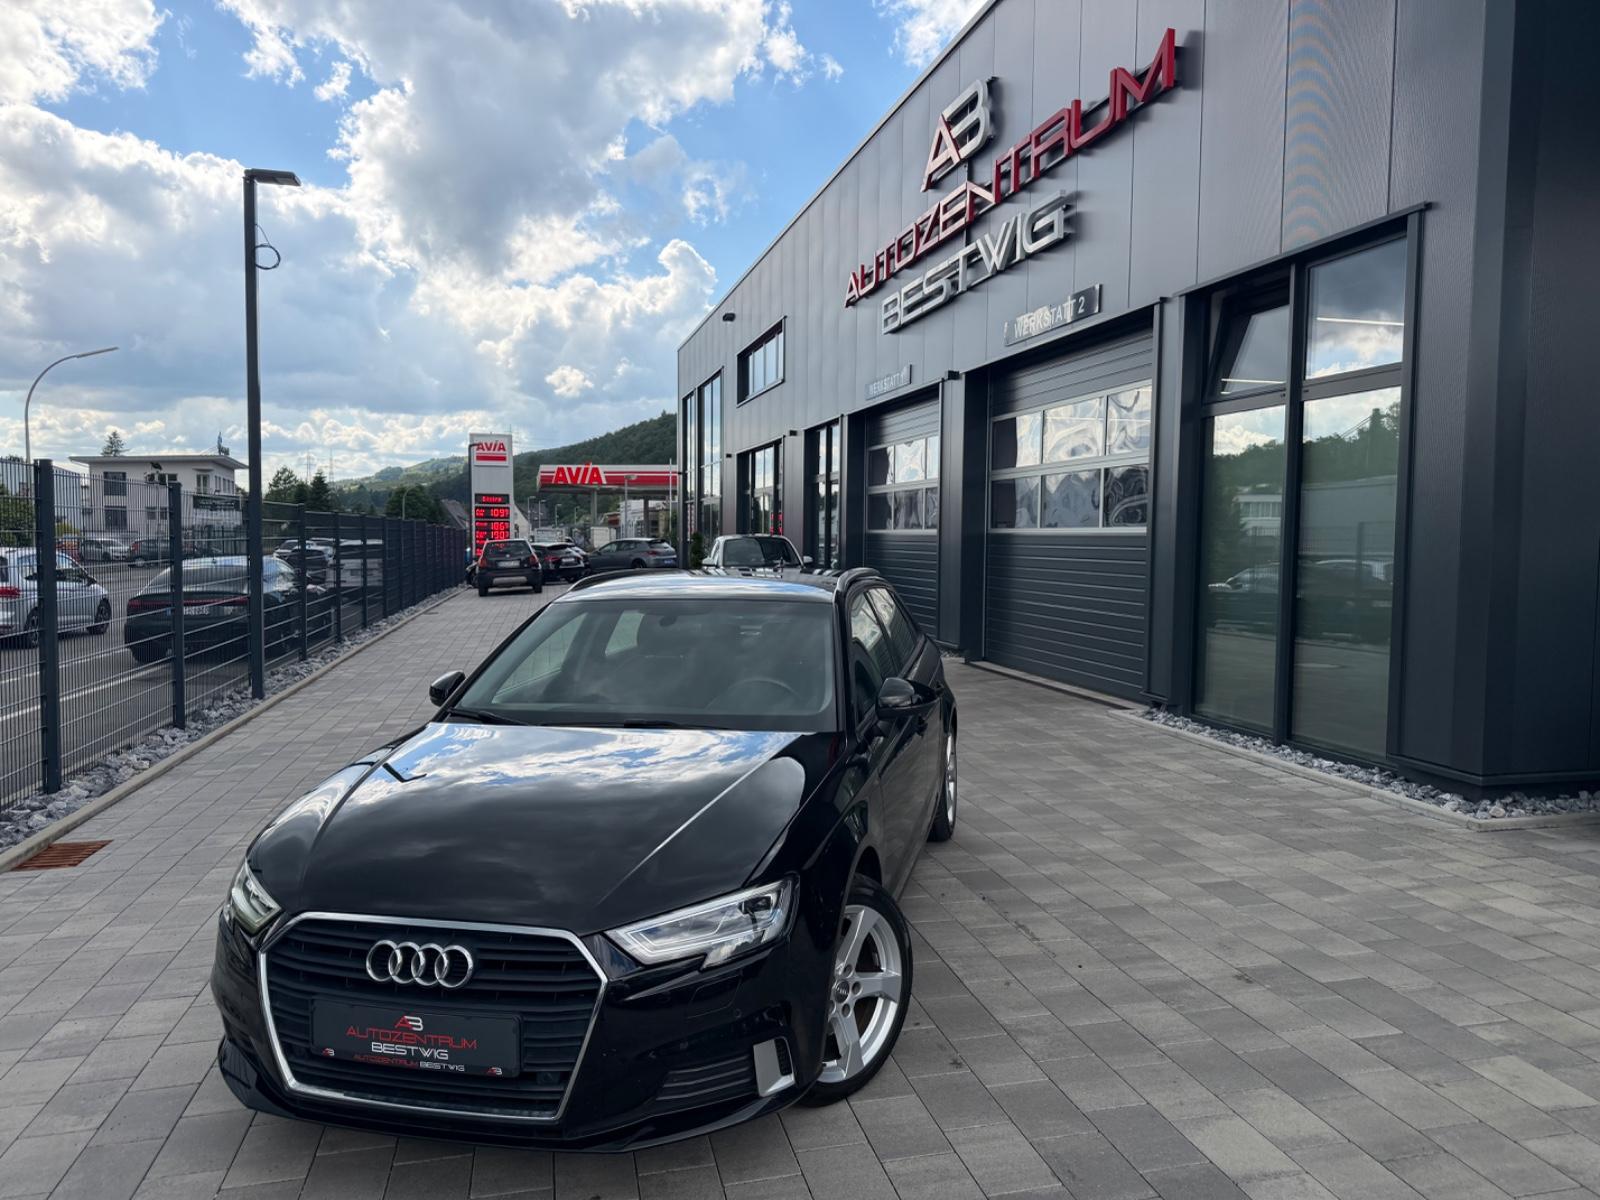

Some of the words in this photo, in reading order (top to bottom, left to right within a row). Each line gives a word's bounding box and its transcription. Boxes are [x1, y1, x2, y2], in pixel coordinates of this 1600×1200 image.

[845, 28, 1175, 307] AUTOZENTRUM
[882, 190, 1066, 334] BESTWIG
[1014, 299, 1076, 338] WERKSTATT
[1078, 296, 1085, 314] 2
[476, 441, 506, 451] AVIA
[552, 461, 606, 485] AVIA
[346, 1026, 477, 1049] AUTOZENTRUM
[371, 1042, 448, 1060] BESTWIG
[420, 1061, 465, 1072] BESTWIG
